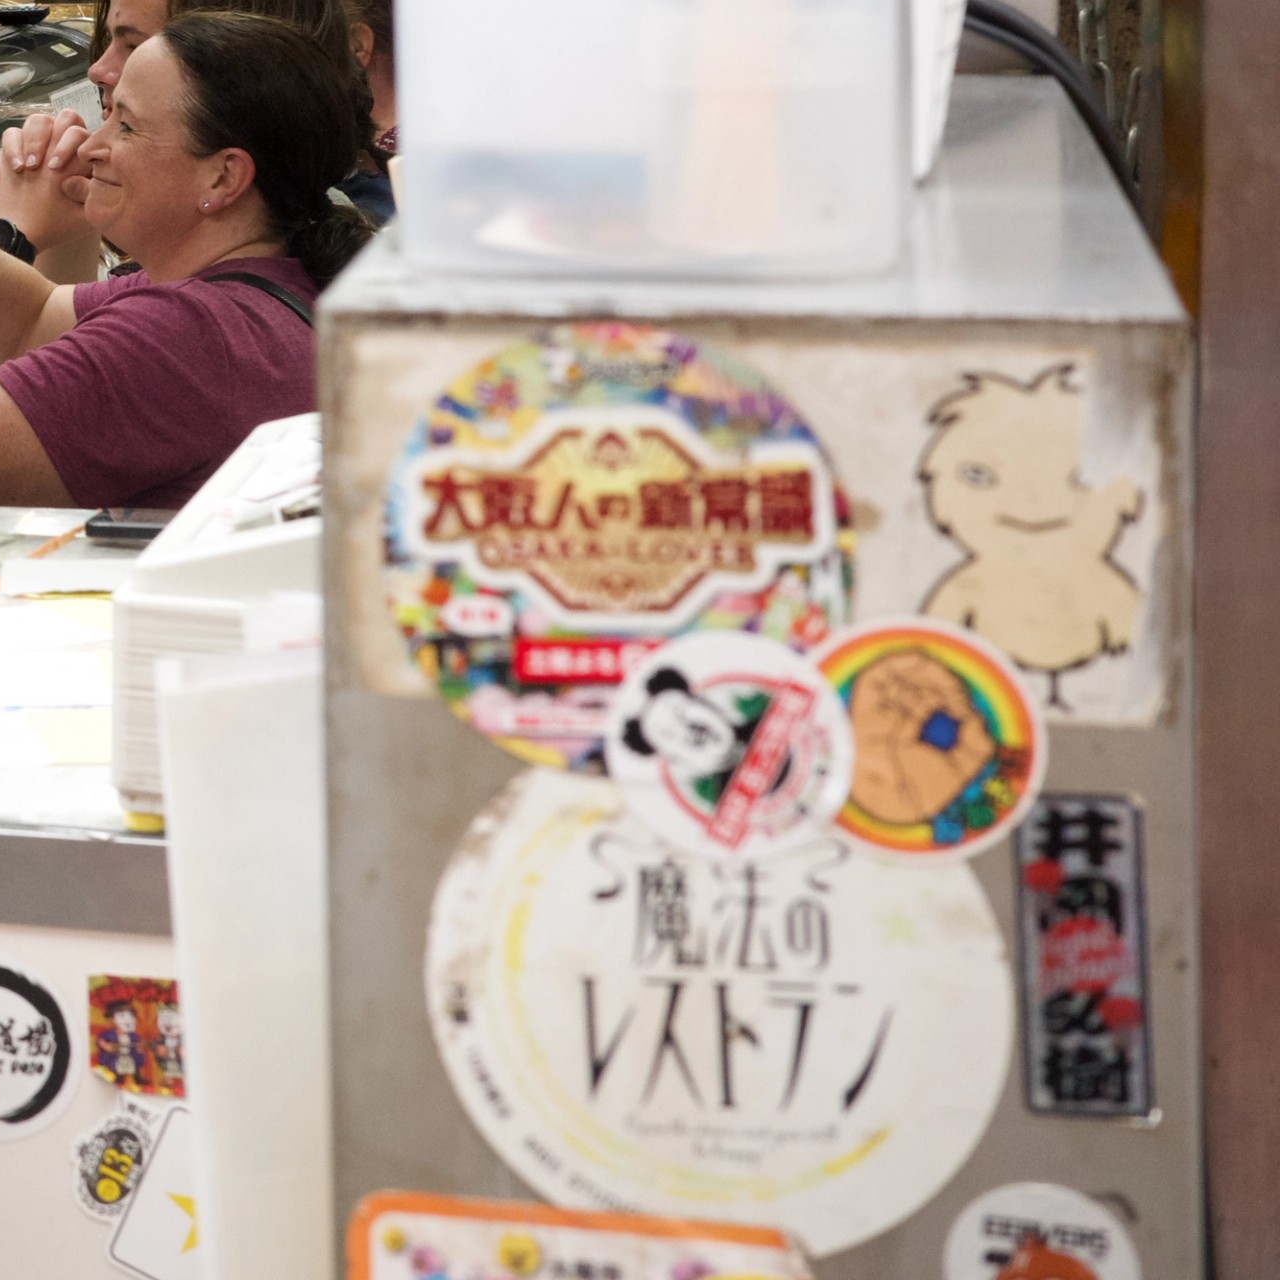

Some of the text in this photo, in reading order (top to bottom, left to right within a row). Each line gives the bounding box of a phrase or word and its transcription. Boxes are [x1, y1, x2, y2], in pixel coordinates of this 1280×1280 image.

[638, 858, 830, 967] 魔法の
[578, 978, 894, 1113] レストラン
